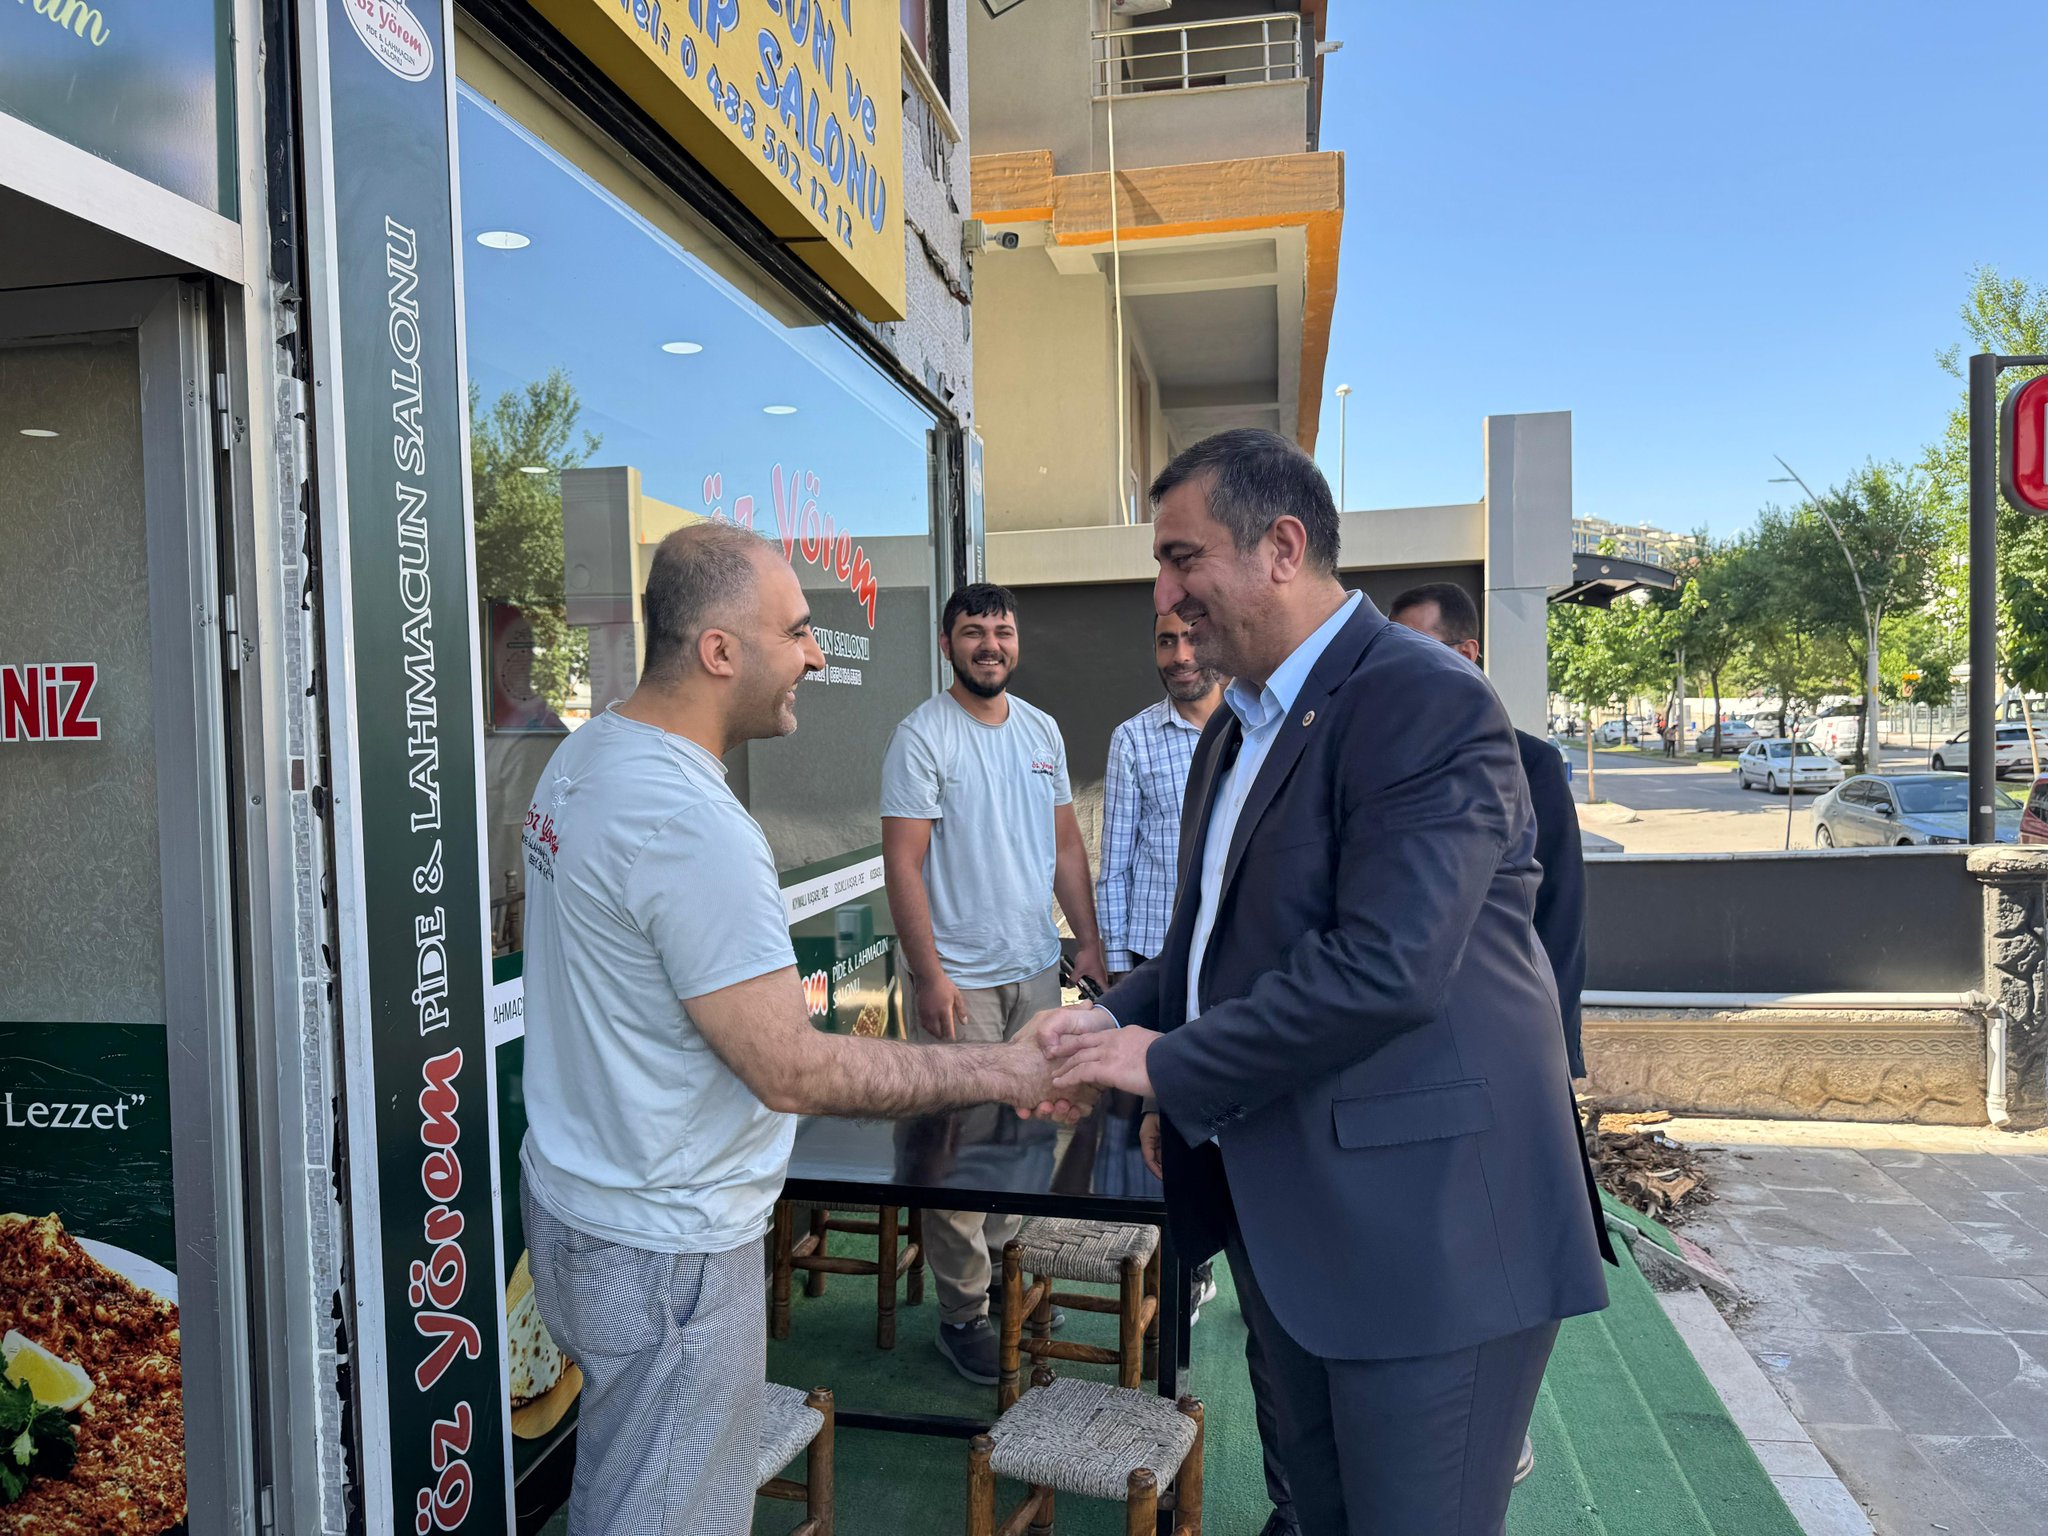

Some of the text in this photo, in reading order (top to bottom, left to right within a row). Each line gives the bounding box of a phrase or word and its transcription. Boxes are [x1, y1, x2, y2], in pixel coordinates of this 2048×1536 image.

[680, 34, 698, 81] 0
[706, 63, 756, 142] 488
[762, 123, 802, 196] 502
[809, 175, 830, 225] 12
[835, 204, 854, 251] 12
[755, 27, 888, 235] SALONU
[845, 62, 877, 147] ve
[385, 214, 425, 476] SALONU
[395, 481, 442, 834] LAHMACUN
[413, 838, 444, 895] &
[493, 997, 524, 1025] AHMAC
[854, 936, 889, 970] LAHMACUN
